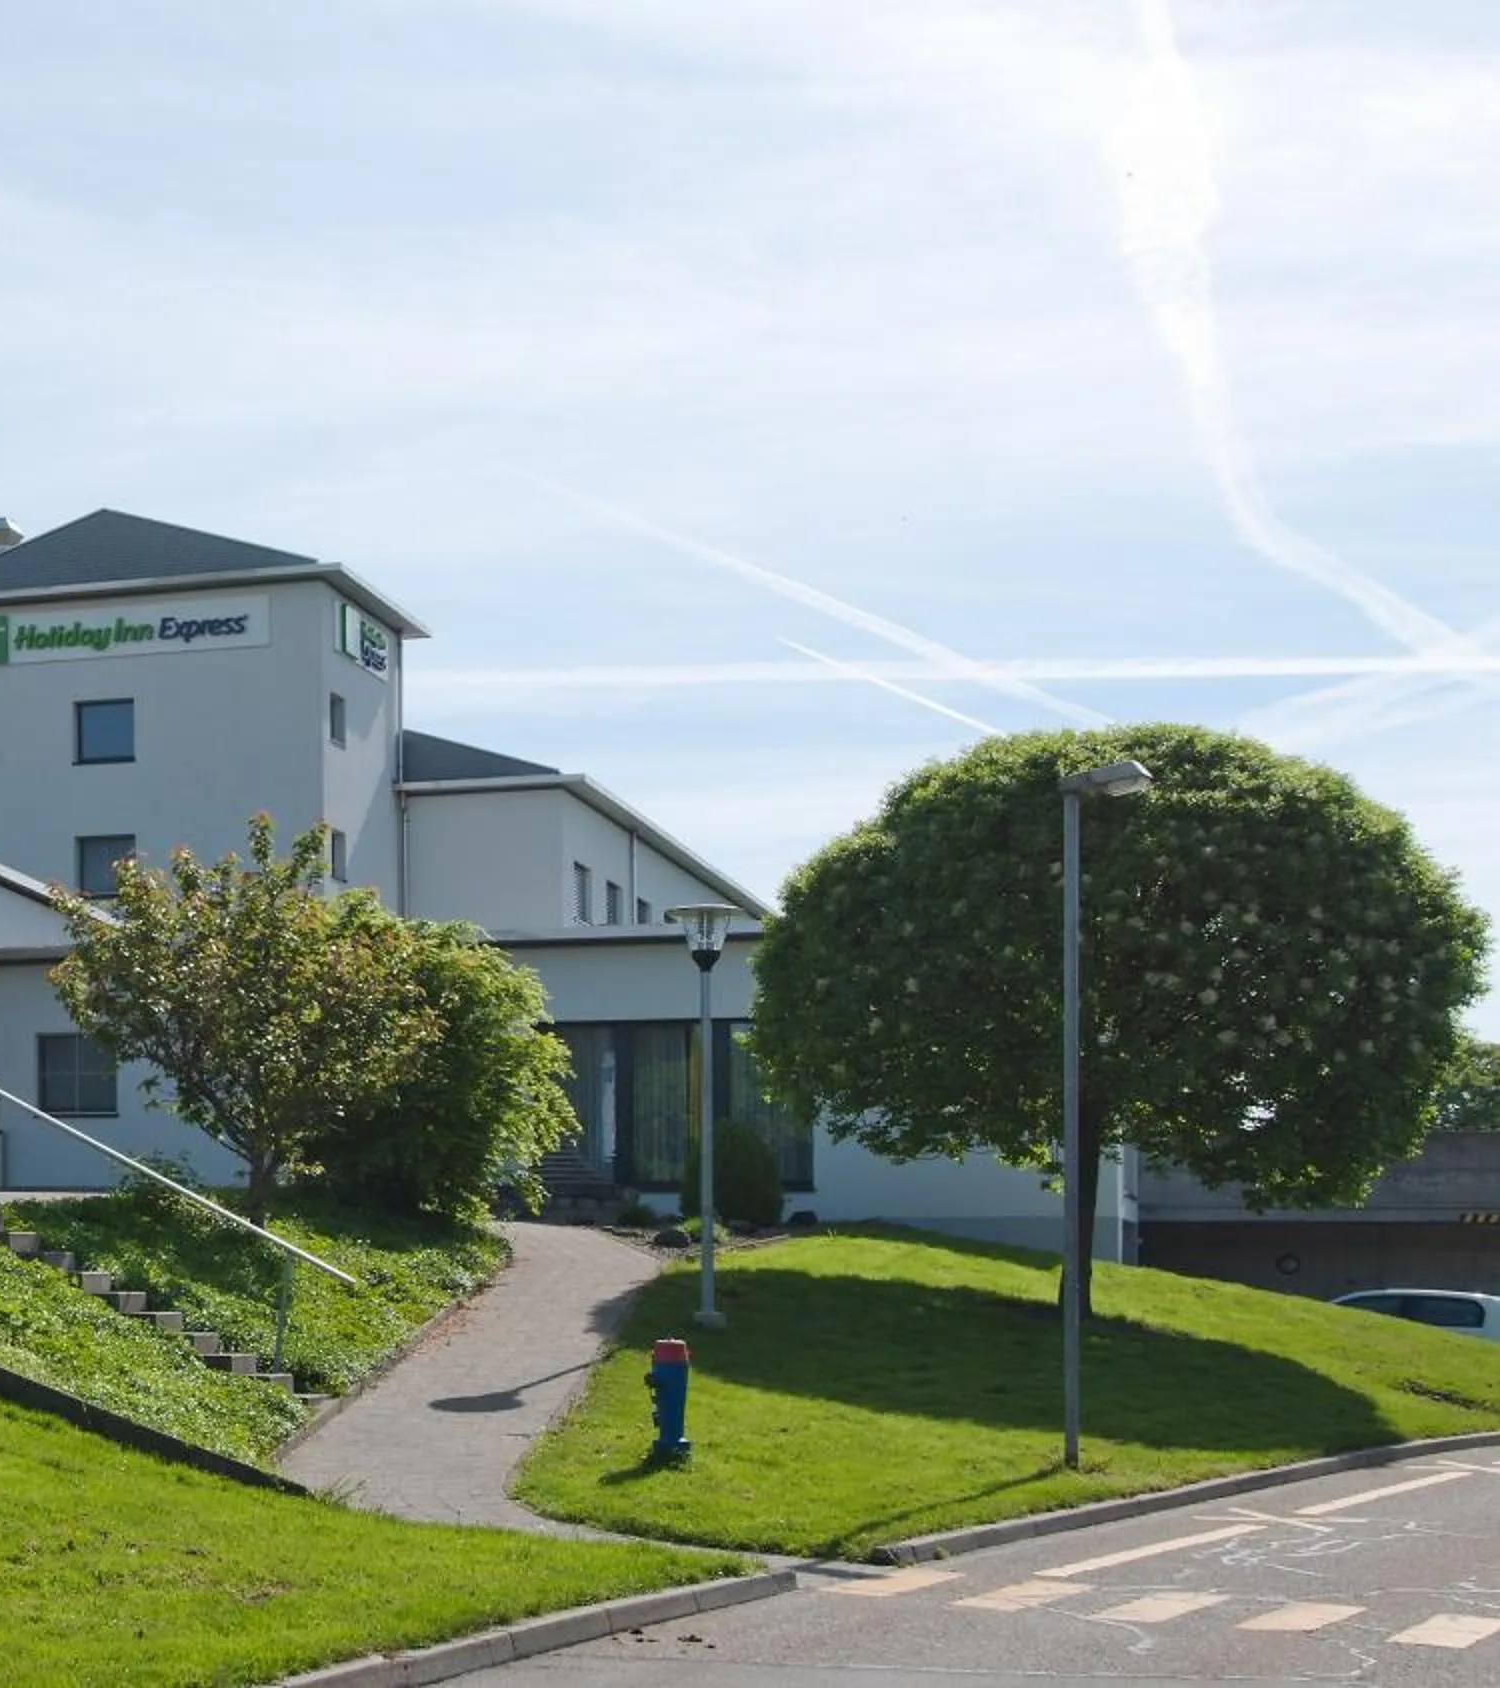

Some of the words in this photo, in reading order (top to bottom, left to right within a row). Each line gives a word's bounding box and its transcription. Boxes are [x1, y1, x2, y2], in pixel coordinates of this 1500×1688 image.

[14, 621, 112, 651] Holiday
[113, 617, 154, 643] Inn
[158, 615, 248, 643] Express
